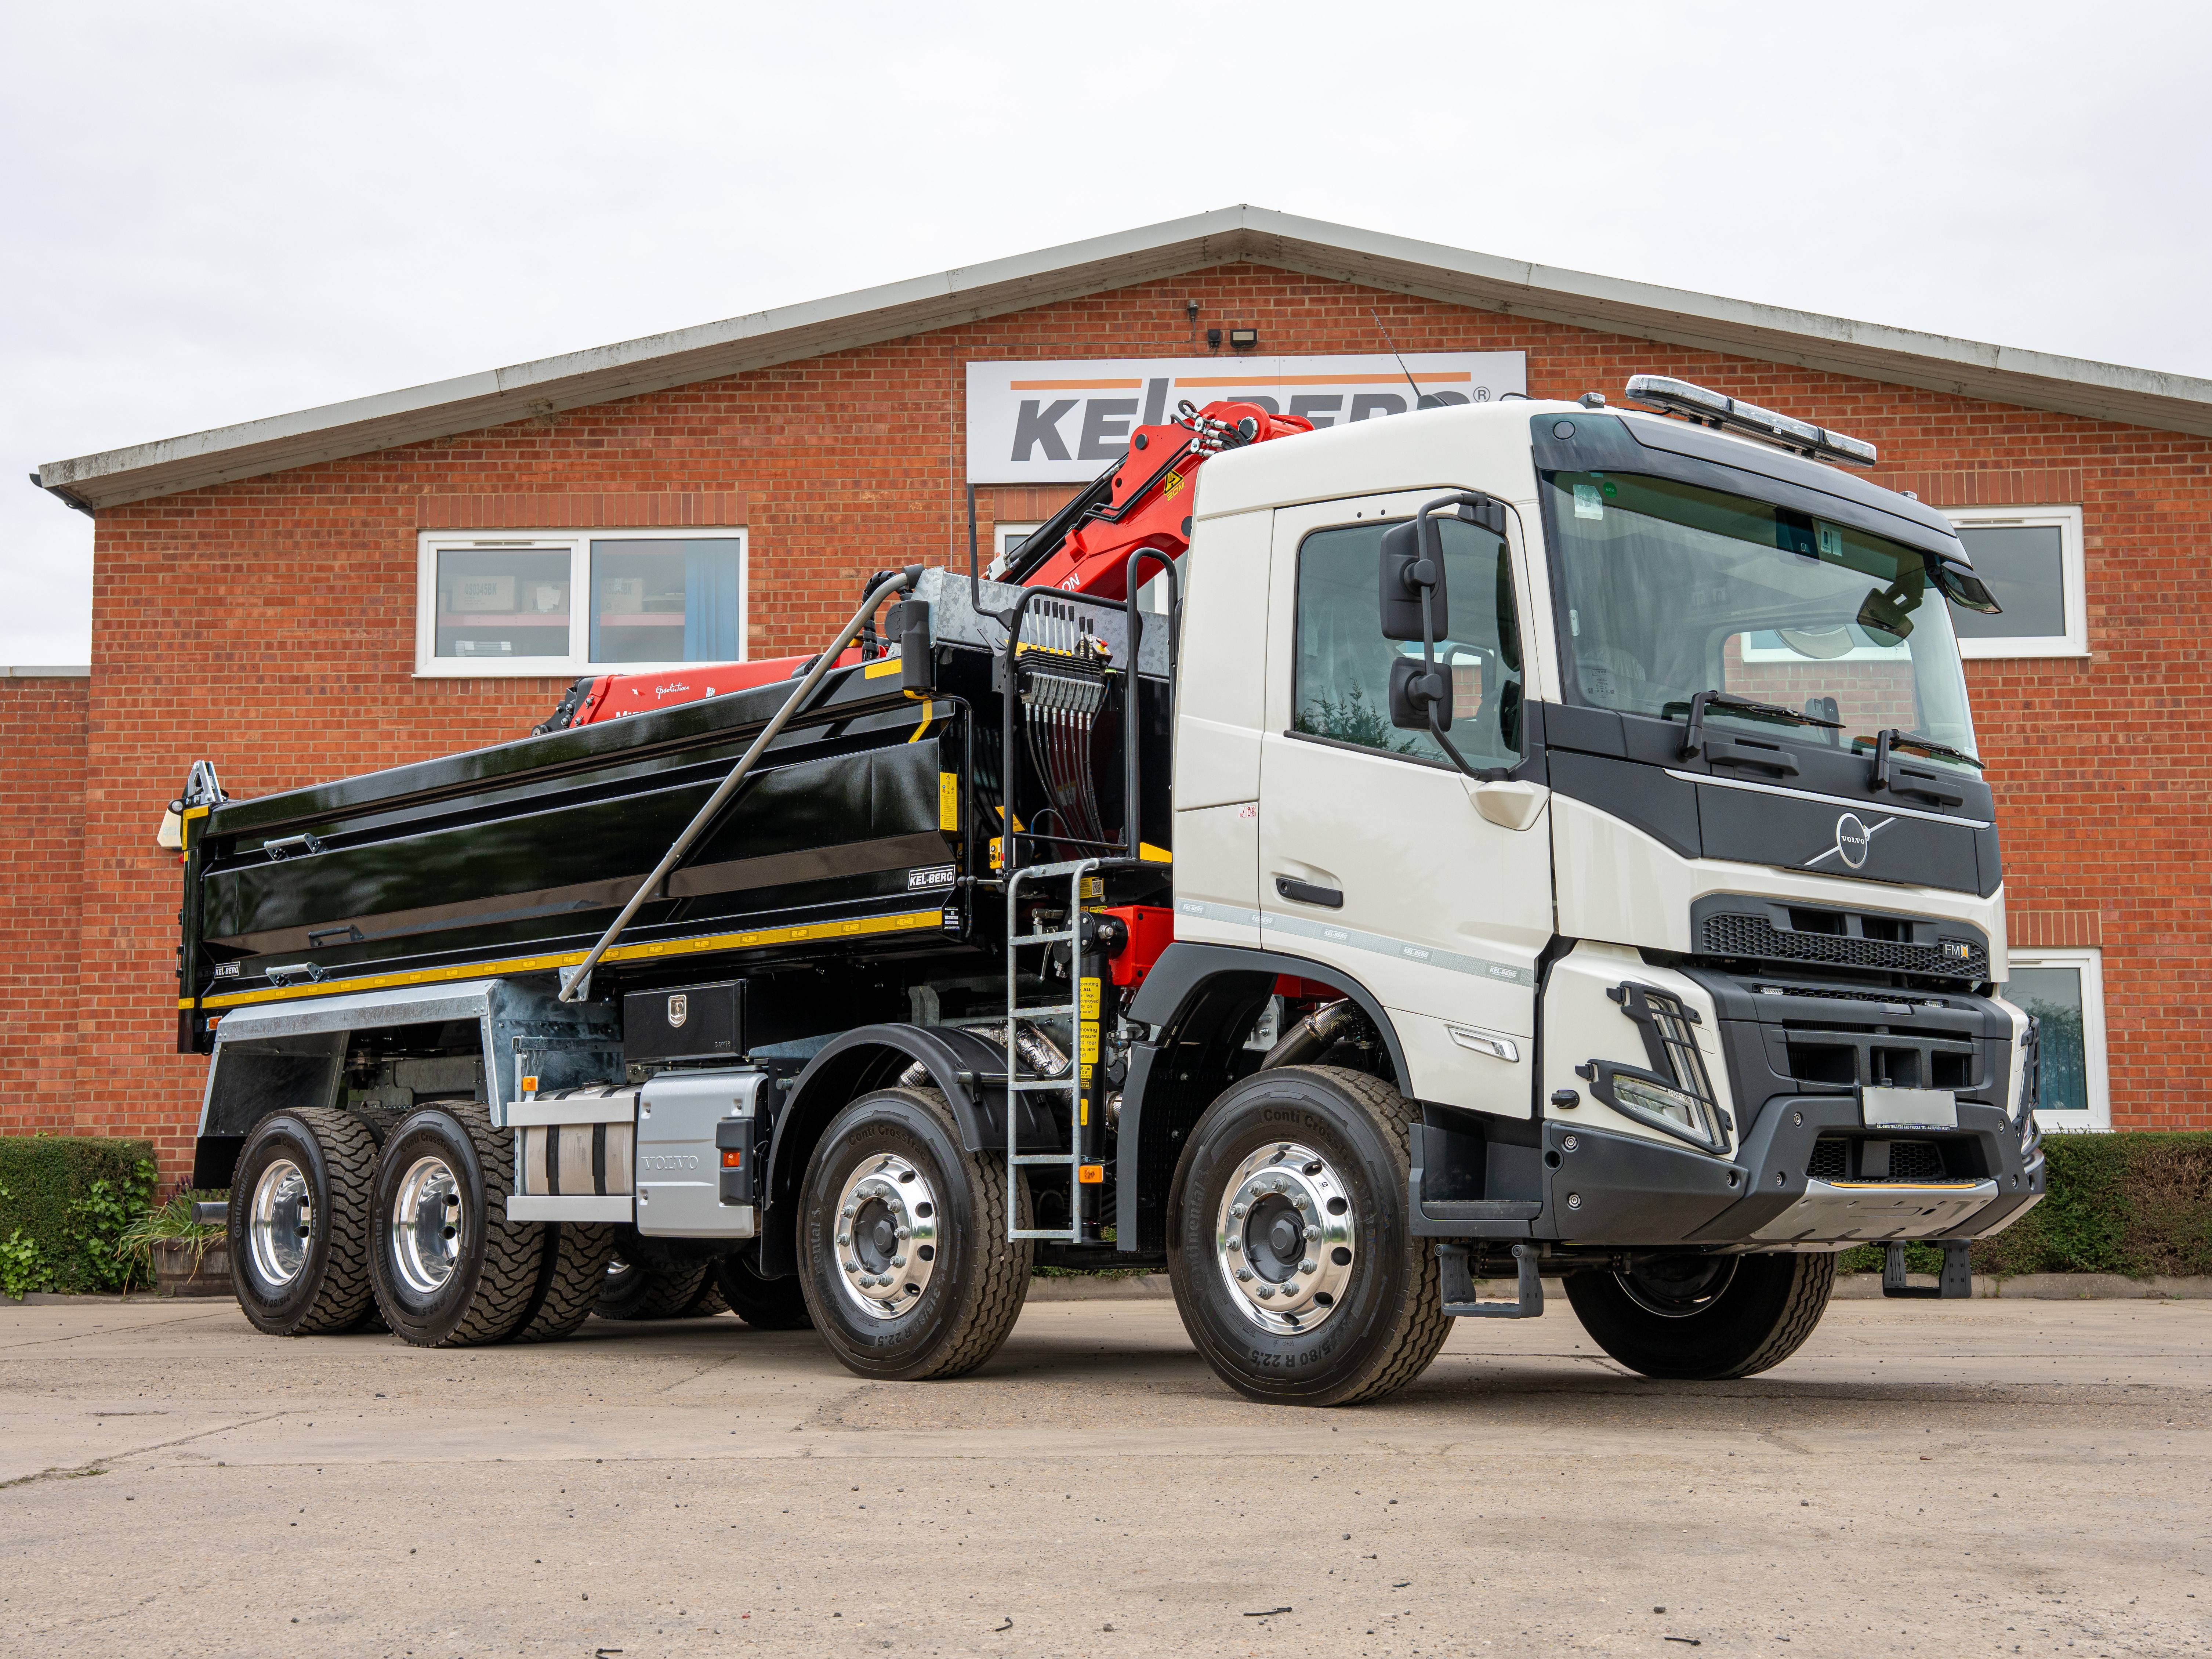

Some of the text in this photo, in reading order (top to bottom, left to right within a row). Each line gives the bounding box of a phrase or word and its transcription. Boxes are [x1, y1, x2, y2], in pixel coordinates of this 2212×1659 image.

[465, 583, 497, 595] QS0345BK
[656, 682, 689, 700] Epsolution
[1841, 836, 1865, 844] VOLVO
[910, 871, 953, 886] KEL-BERG
[1324, 930, 1347, 939] KEL-BERG
[1403, 948, 1428, 958] KEL-BERG
[1945, 944, 1969, 959] FMX
[215, 966, 238, 976] KEL-BERG
[1490, 967, 1516, 977] KEL-BERG
[1263, 1108, 1300, 1124] Conti
[400, 1135, 419, 1153] Conti
[848, 1126, 875, 1146] Conti
[878, 1124, 925, 1160] CrossTrac
[641, 1156, 698, 1170] VOLVO
[235, 1167, 250, 1239] Continental
[1186, 1181, 1212, 1291] Continental
[877, 1287, 940, 1345] 315/80 R 22.5
[1250, 1350, 1281, 1368] 22.5
[1285, 1354, 1295, 1368] R
